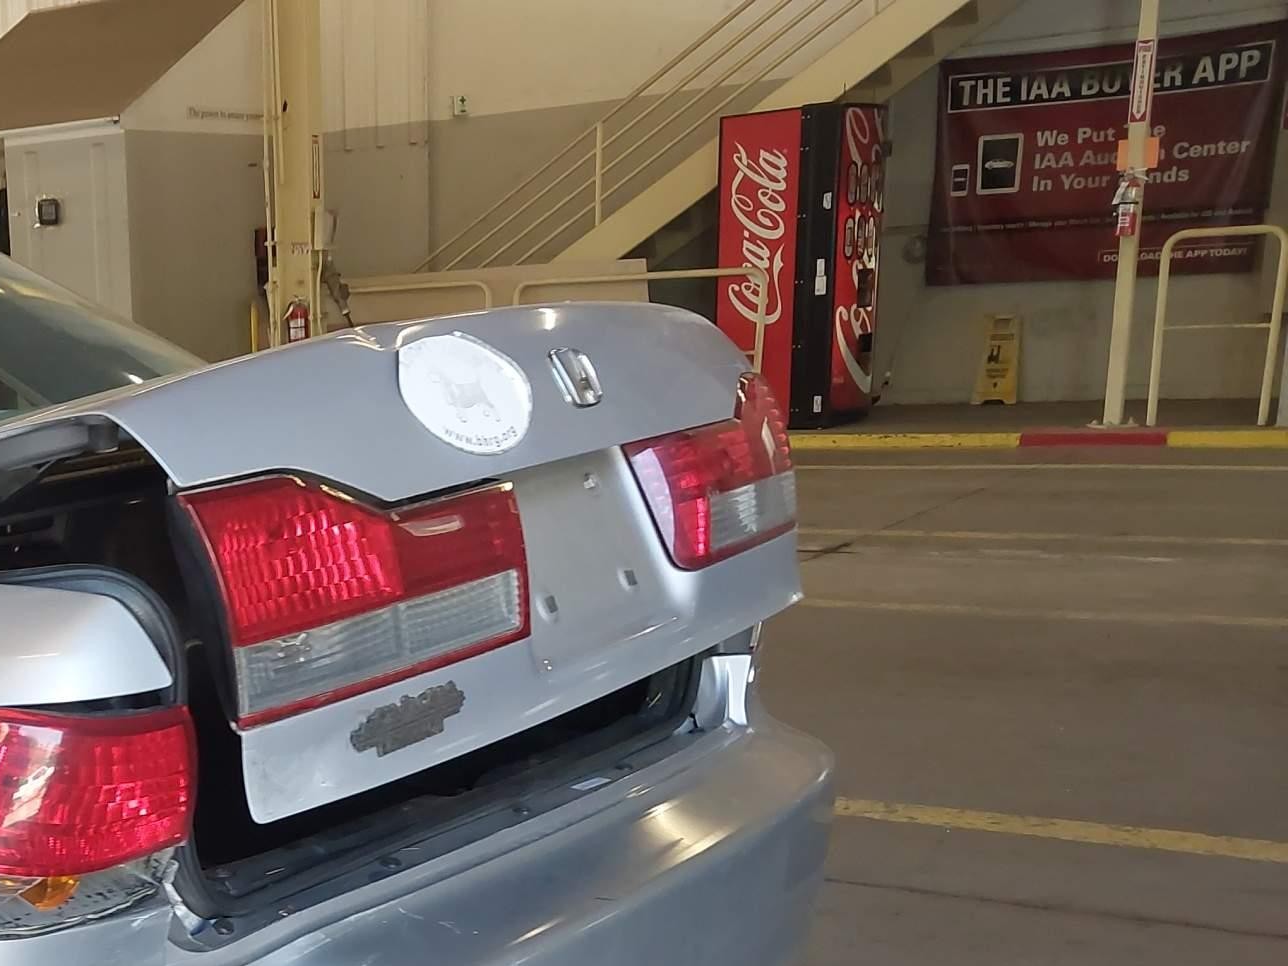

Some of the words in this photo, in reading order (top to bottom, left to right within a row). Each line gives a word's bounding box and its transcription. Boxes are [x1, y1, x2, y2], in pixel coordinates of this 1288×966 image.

[958, 76, 1012, 106] THE
[1020, 72, 1072, 101] IAA
[1080, 61, 1184, 96] BUR
[1191, 49, 1262, 85] APP
[1036, 129, 1070, 147] We
[1077, 126, 1116, 144] Put
[1034, 151, 1074, 169] IAA
[1172, 139, 1251, 160] Center
[1032, 175, 1053, 192] In
[1061, 173, 1111, 190] Your
[1185, 249, 1208, 258] APP
